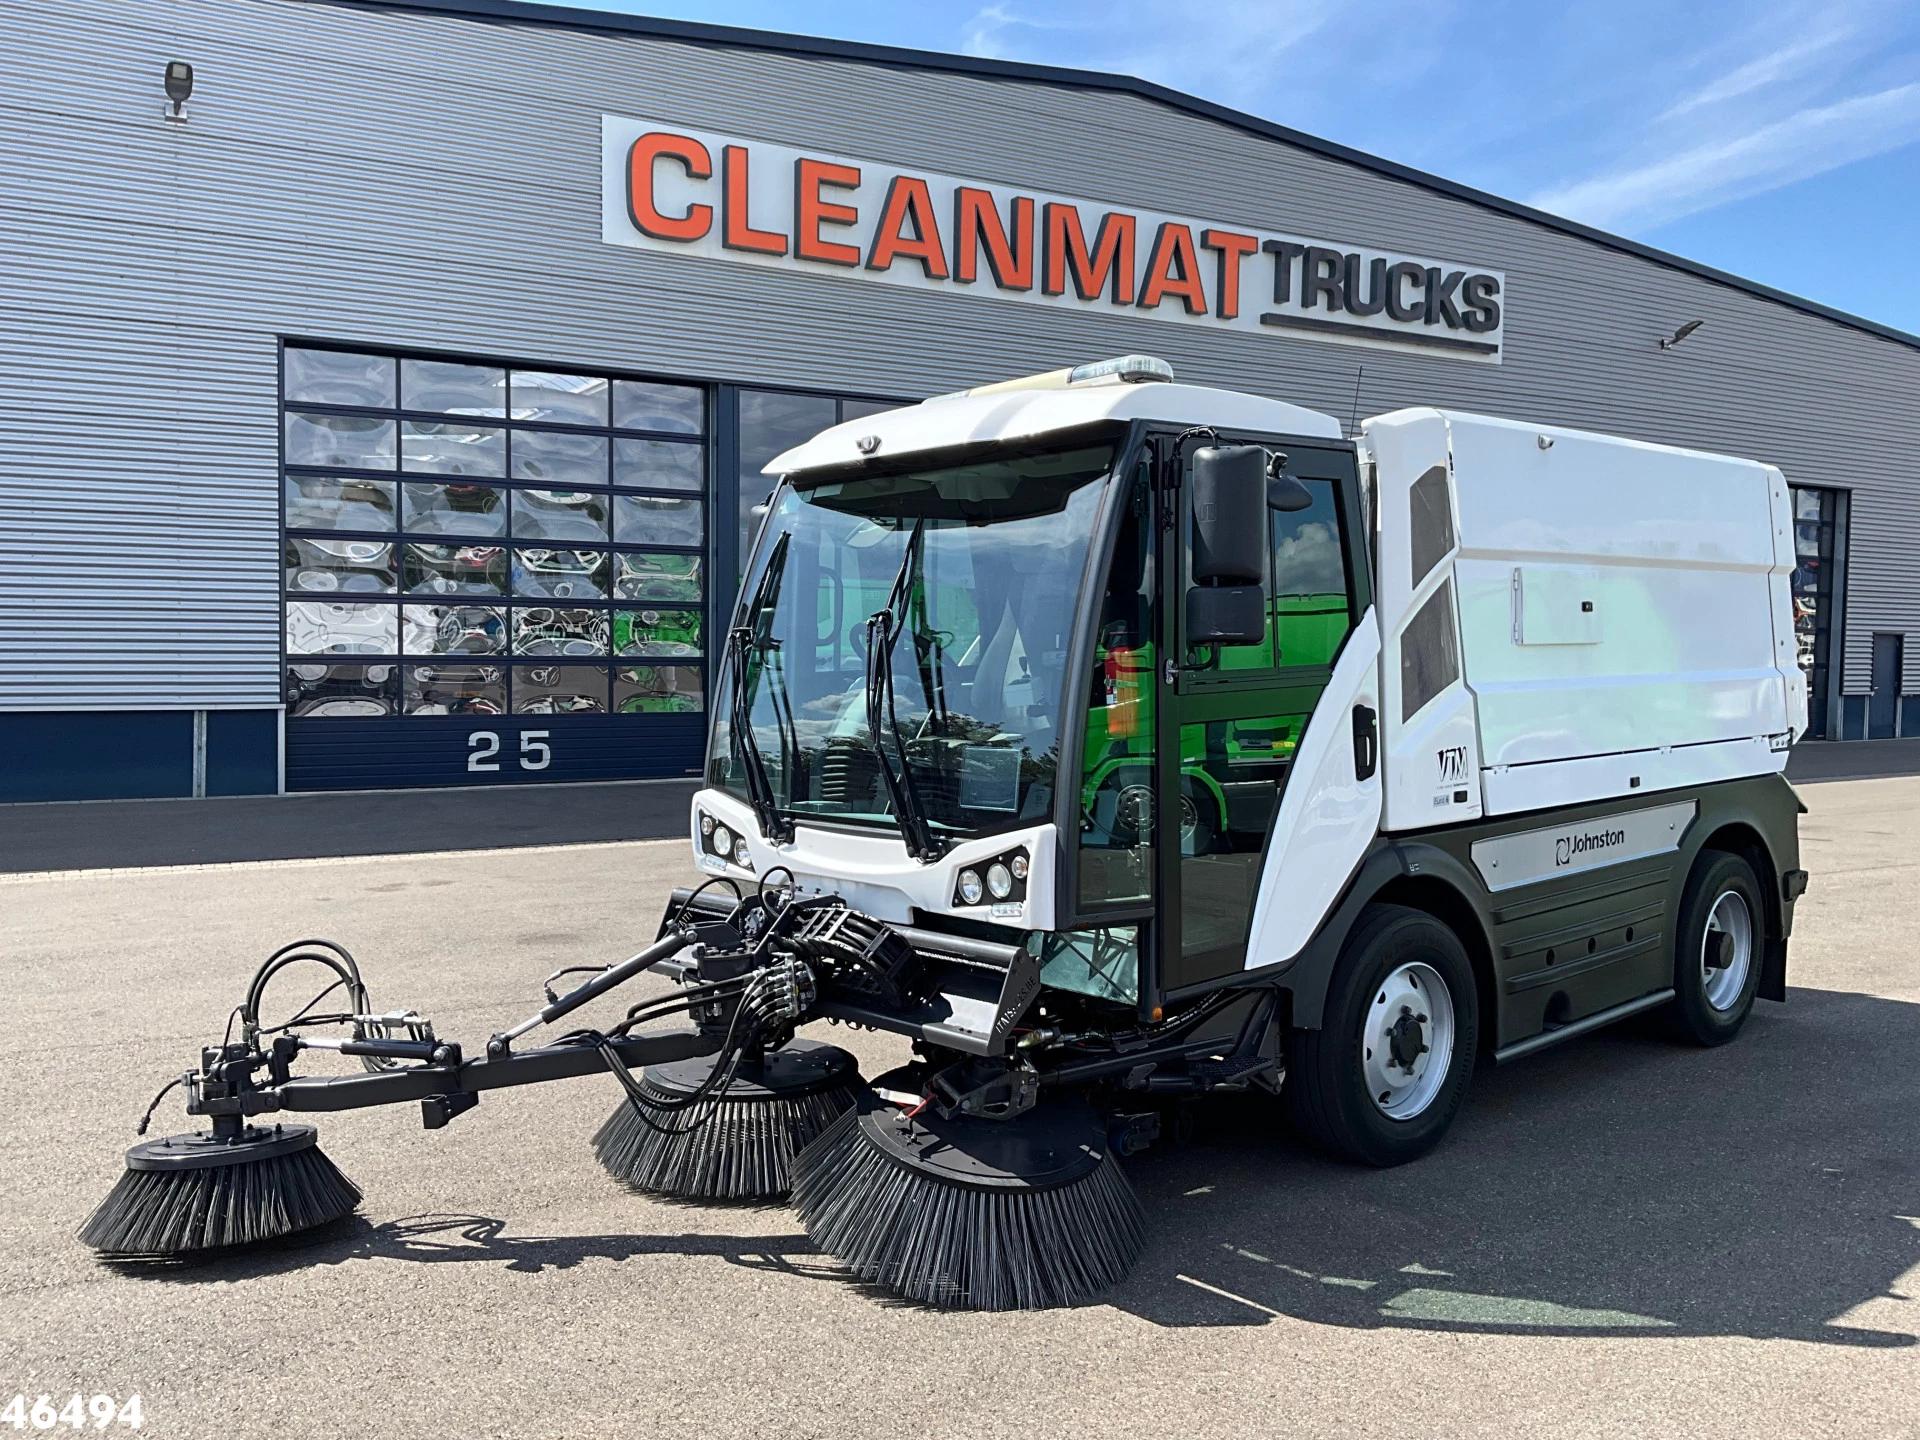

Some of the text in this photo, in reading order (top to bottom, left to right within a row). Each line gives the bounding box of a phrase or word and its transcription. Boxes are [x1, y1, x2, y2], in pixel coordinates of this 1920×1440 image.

[626, 132, 1501, 333] CLEANMAT TRUCKS
[1436, 745, 1469, 782] VTM
[1571, 829, 1625, 854] Johnston
